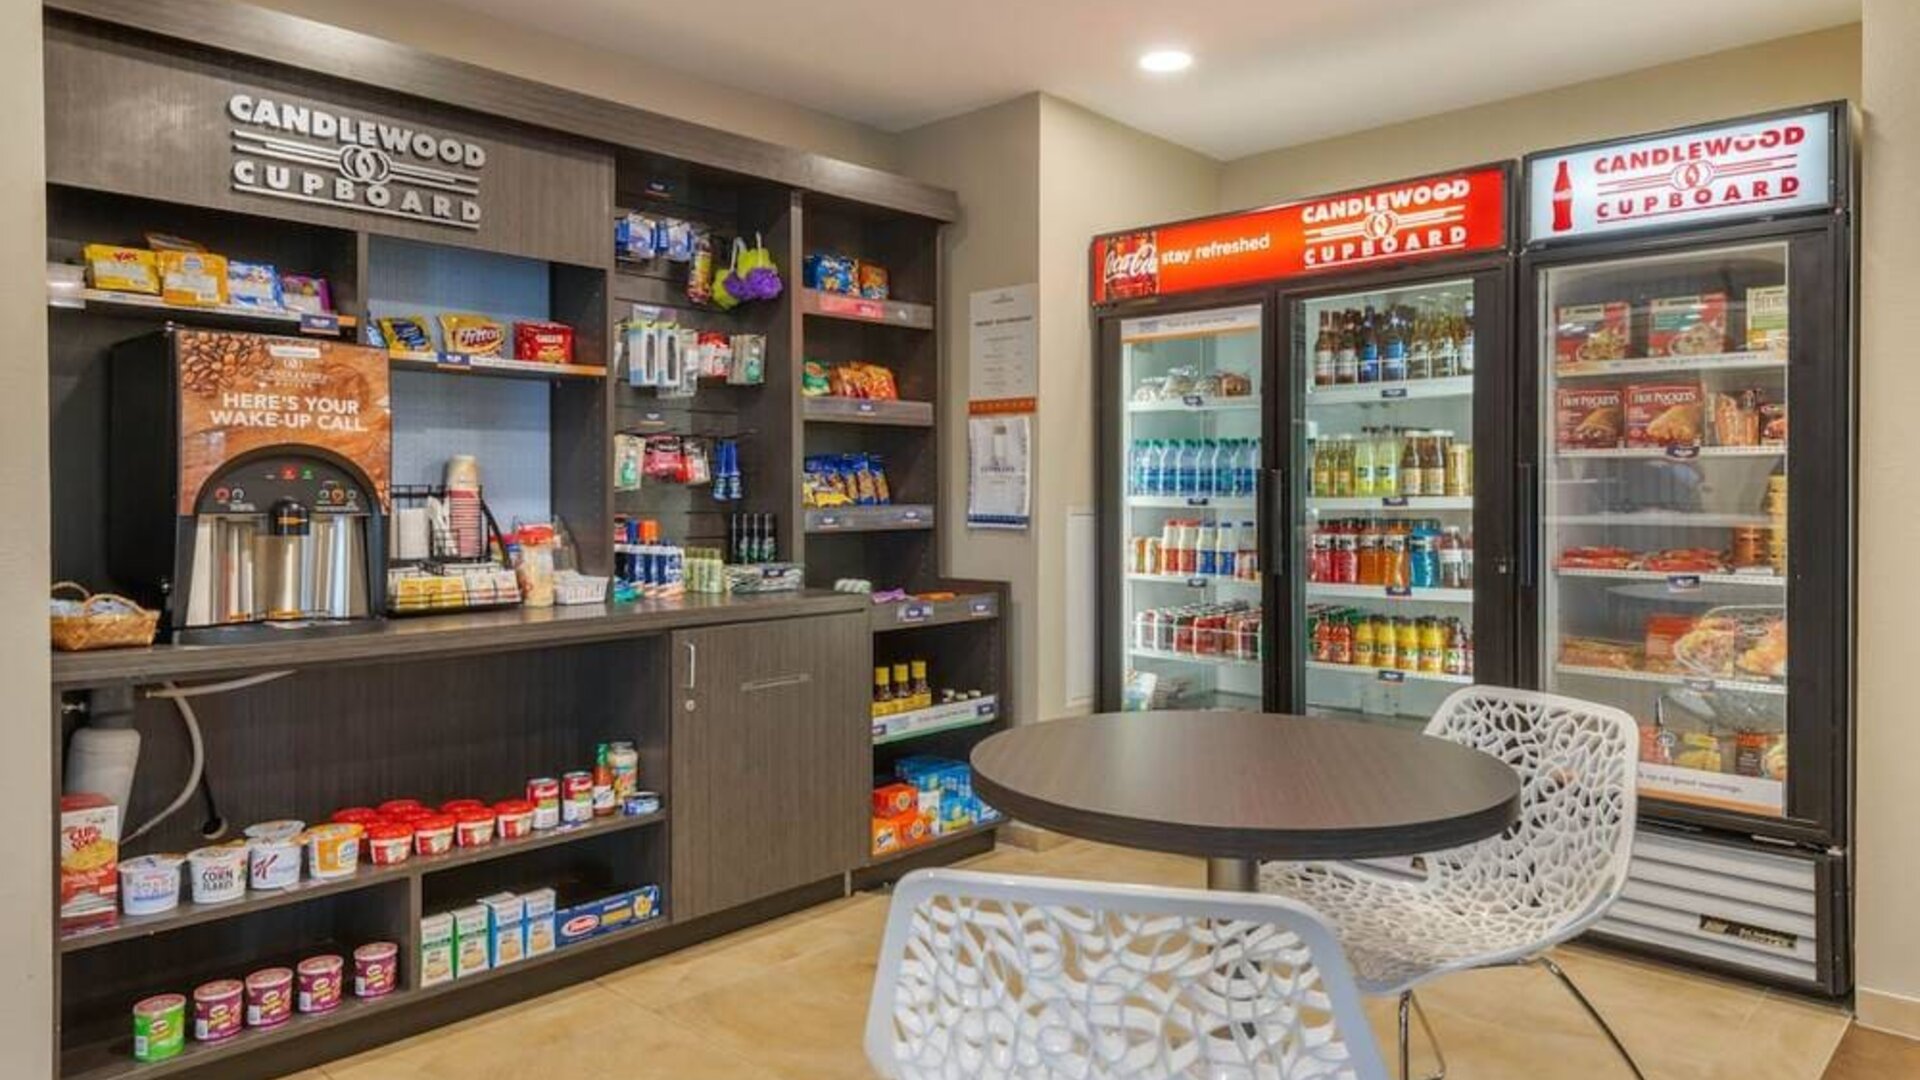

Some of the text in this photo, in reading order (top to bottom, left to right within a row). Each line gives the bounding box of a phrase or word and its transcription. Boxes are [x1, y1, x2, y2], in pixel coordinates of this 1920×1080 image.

[229, 95, 486, 168] CANDLEWOOD
[1594, 126, 1805, 174] CANDLEWOOD
[232, 160, 482, 223] CUPBOARD
[1302, 179, 1471, 223] CANDLEWOOD
[1597, 176, 1799, 218] CUPBOARD
[1161, 234, 1270, 266] stay refreshed
[1304, 226, 1467, 265] CUPBOARD
[210, 410, 311, 429] WAKE-UP
[222, 392, 359, 414] HERE'S YOUR
[203, 868, 233, 882] CORN
